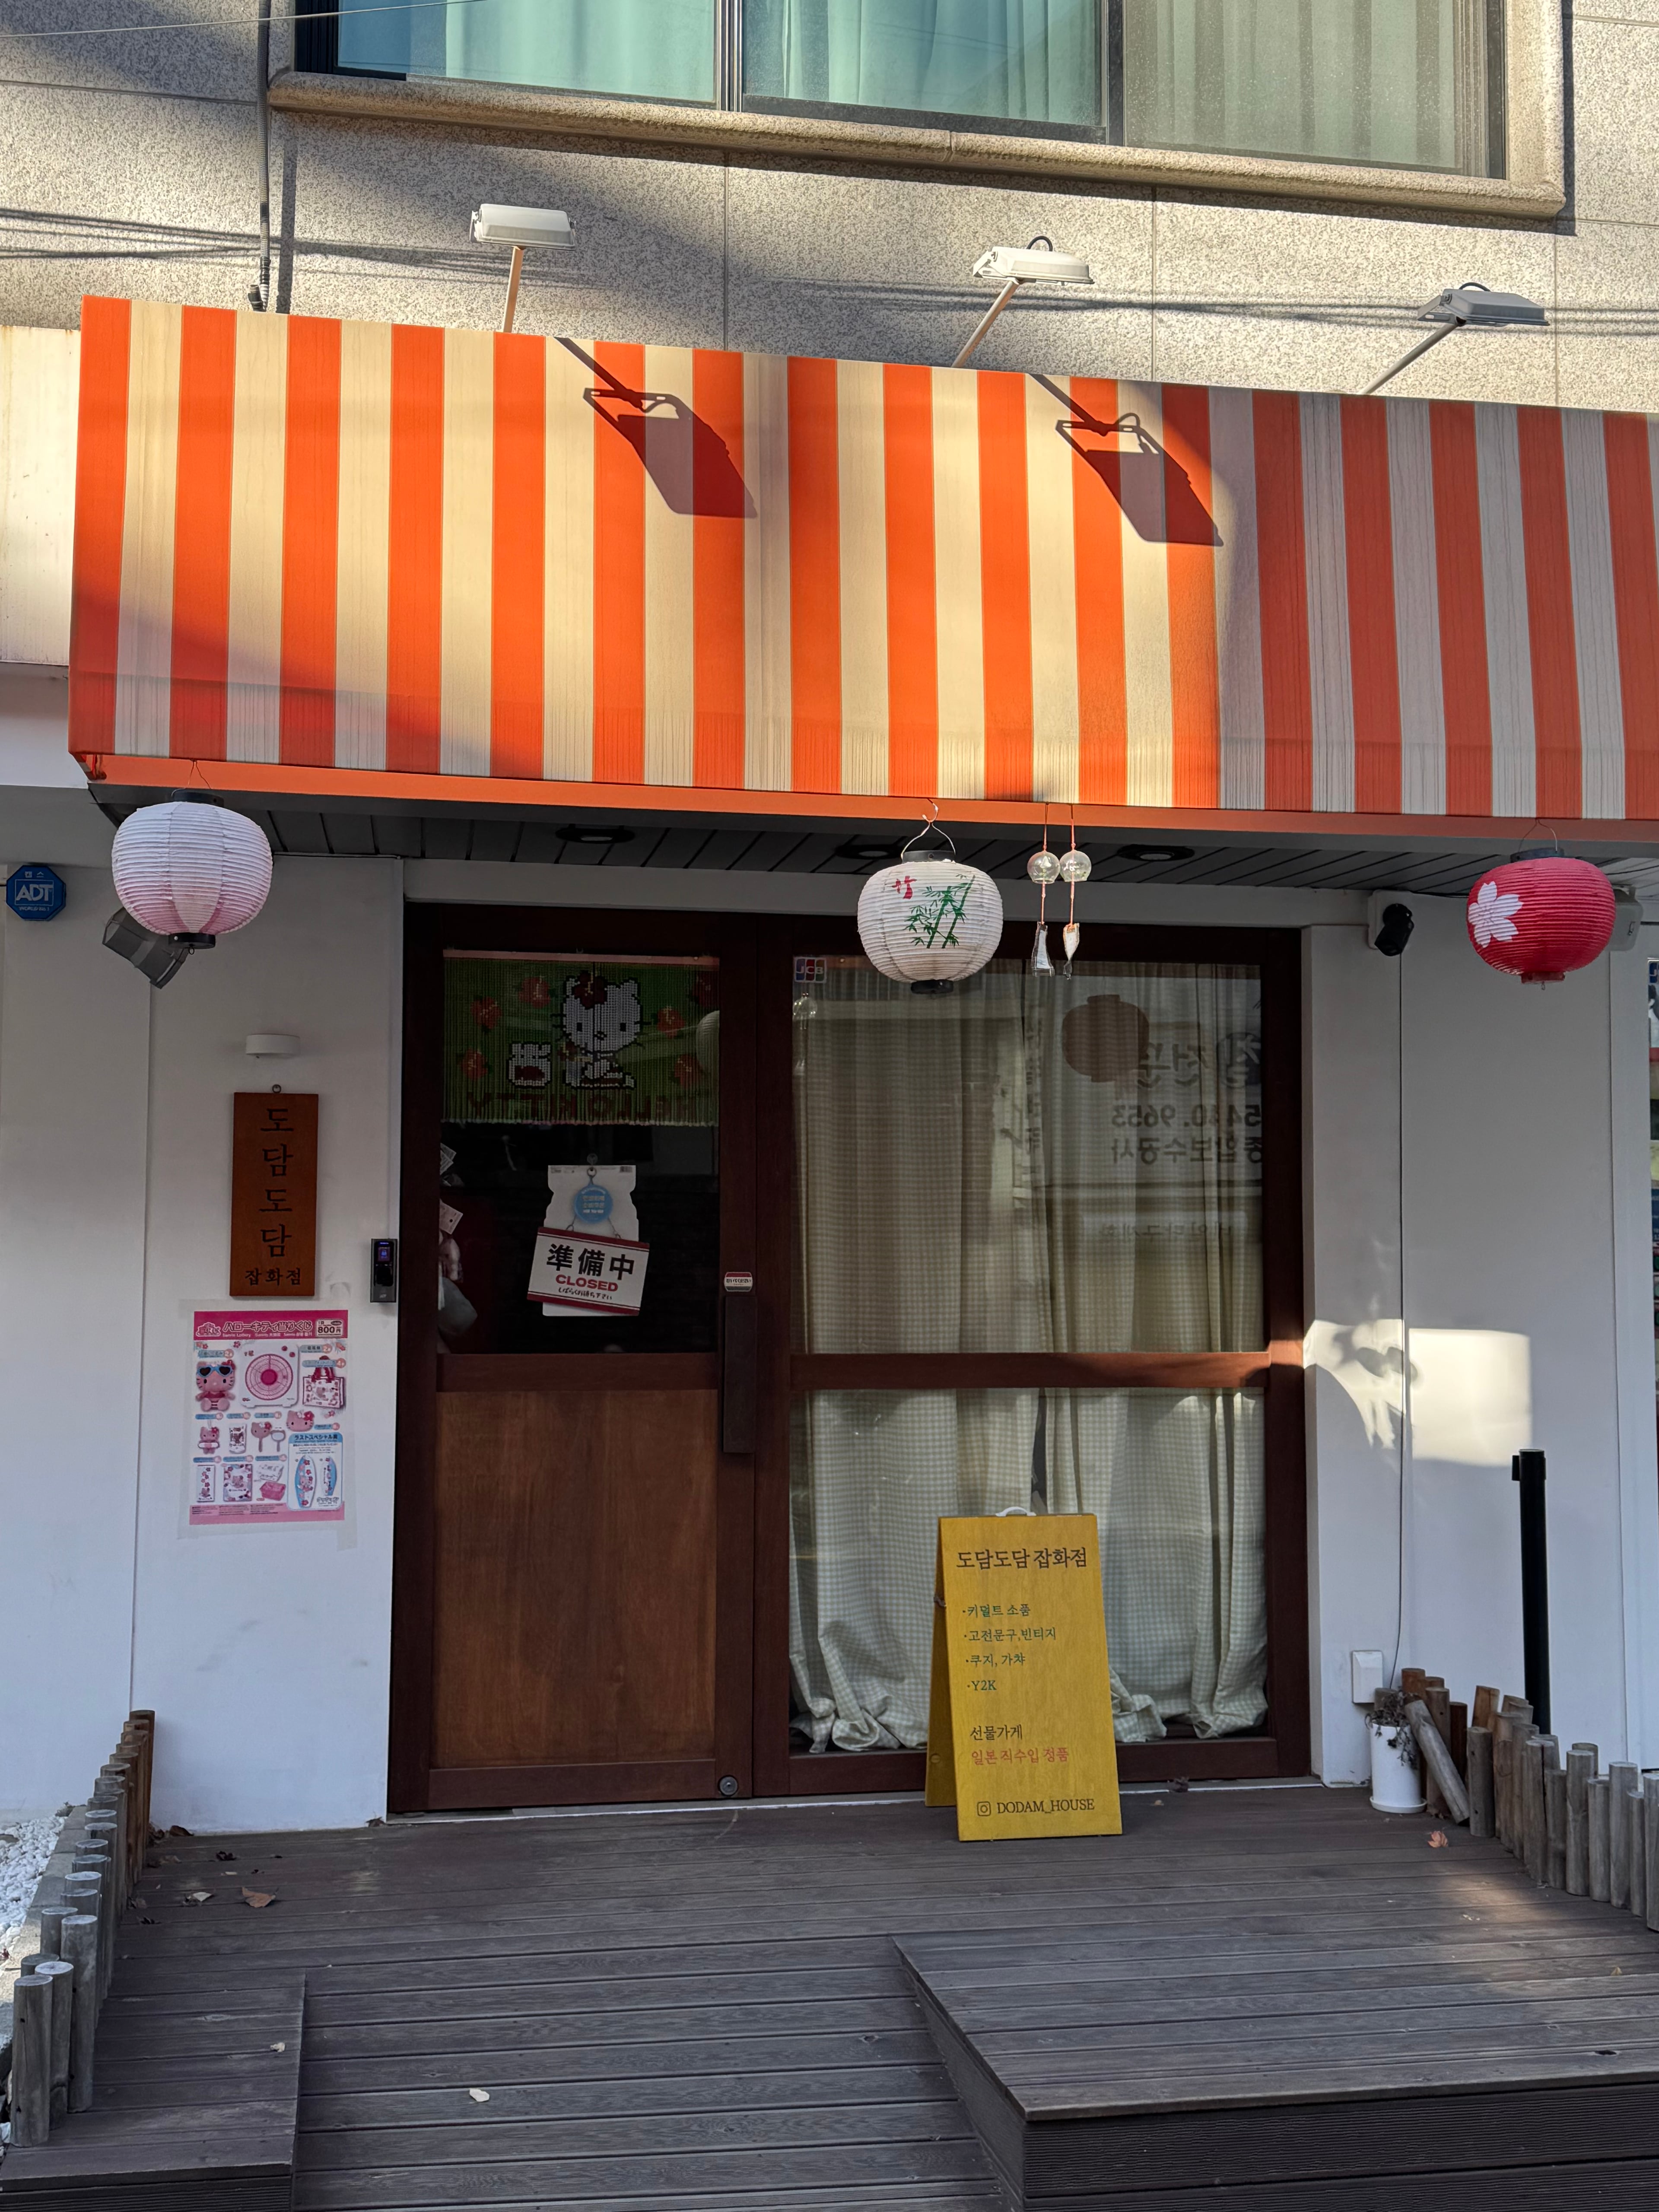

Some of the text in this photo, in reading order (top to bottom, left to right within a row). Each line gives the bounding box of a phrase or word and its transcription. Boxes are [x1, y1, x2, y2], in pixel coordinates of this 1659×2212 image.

[16, 884, 54, 901] ADT
[891, 875, 917, 899] 竹
[796, 966, 824, 974] JCB
[259, 1108, 294, 1258] 도담도담
[546, 1243, 635, 1280] 準備中
[245, 1267, 301, 1287] 잡화점
[555, 1274, 618, 1292] CLOSED
[956, 1546, 1087, 1570] 도담도담 잡화점
[1007, 1604, 1031, 1617] 소품
[1001, 1652, 1026, 1666] 가챠
[971, 1680, 997, 1691] Y2K
[970, 1724, 1023, 1741] 선물가게
[972, 1746, 1069, 1765] 일본 직수입 정품
[997, 1798, 1095, 1814] DODAM_HOUSE
